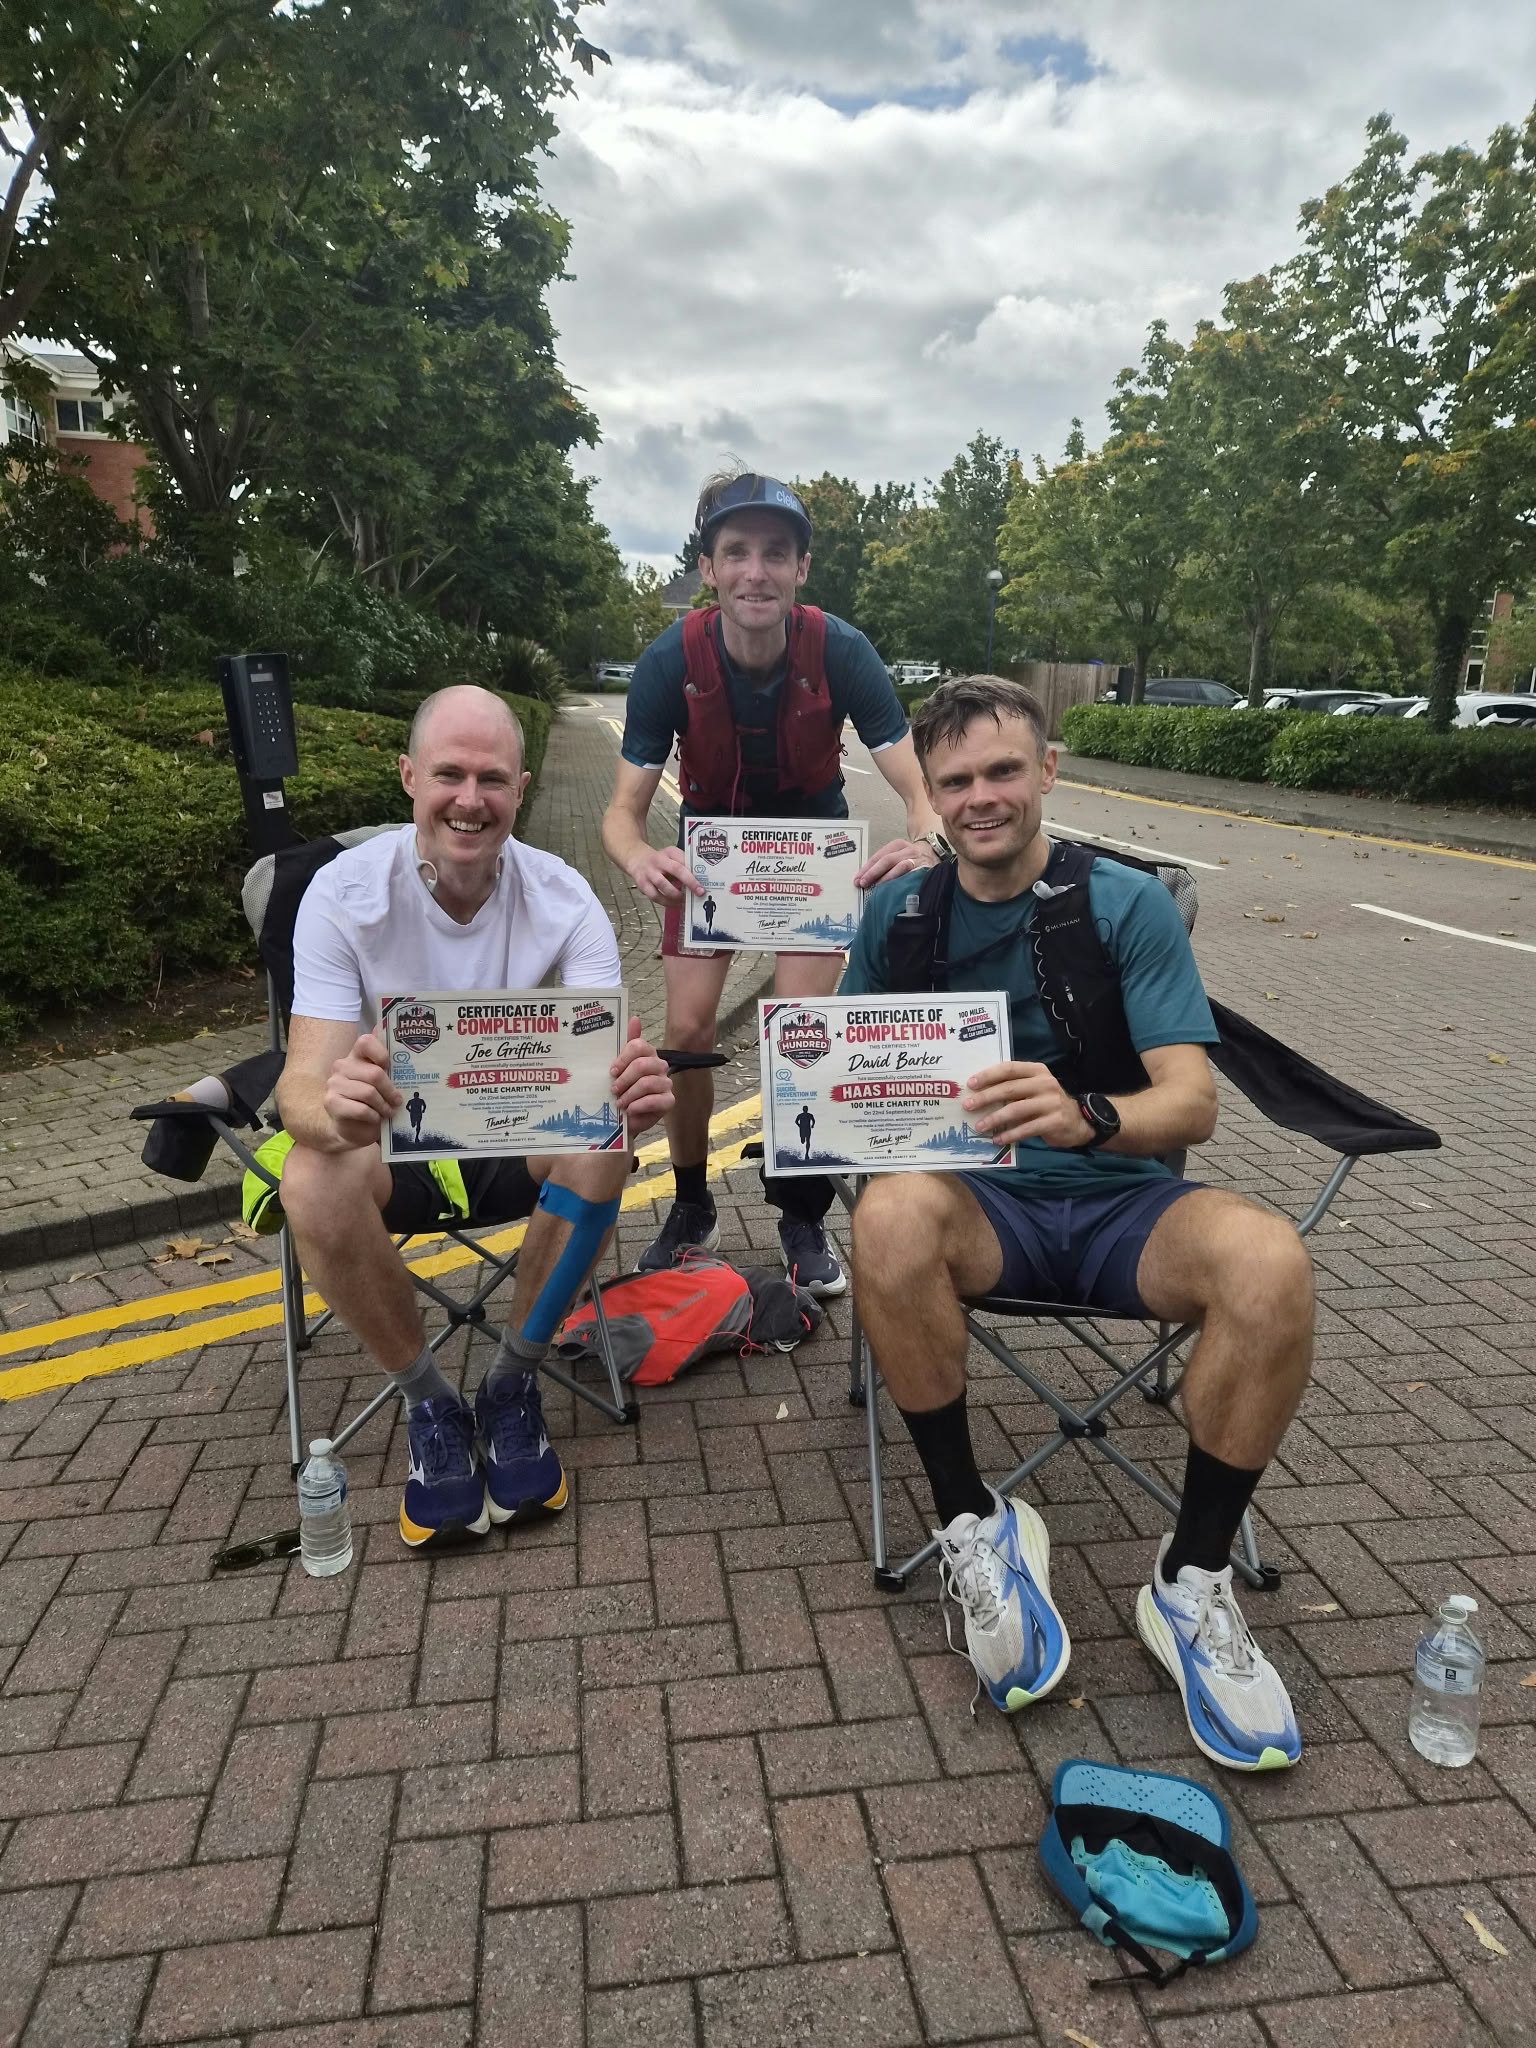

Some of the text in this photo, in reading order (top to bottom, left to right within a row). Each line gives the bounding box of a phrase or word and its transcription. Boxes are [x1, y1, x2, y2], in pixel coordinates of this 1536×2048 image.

[742, 830, 812, 842] CERTIFICATE OF
[699, 846, 727, 854] HUNDRED
[741, 841, 814, 855] COMPLETION
[745, 860, 807, 874] Alex Sewell
[739, 883, 814, 894] HAAS HUNDRED
[757, 917, 790, 928] Thank you!
[457, 1004, 556, 1018] CERTIFICATE OF
[572, 1005, 582, 1013] 100
[958, 1007, 986, 1019] 100 MILES.
[400, 1019, 434, 1028] HAAS
[847, 1008, 943, 1025] CERTIFICATE OF
[397, 1028, 437, 1037] HUNDRED
[457, 1017, 558, 1035] COMPLETION
[846, 1023, 946, 1043] COMPLETION
[785, 1029, 823, 1040] HAAS
[465, 1041, 552, 1061] Joe Griffiths
[782, 1040, 827, 1050] HUNDRED
[848, 1051, 943, 1072] David Barker
[459, 1070, 560, 1086] HAAS HUNDRED
[500, 1085, 533, 1093] CHARITY
[842, 1082, 951, 1099] HAAS HUNDRED
[484, 1112, 529, 1129] Thank you!
[867, 1131, 912, 1147] Thank you!
